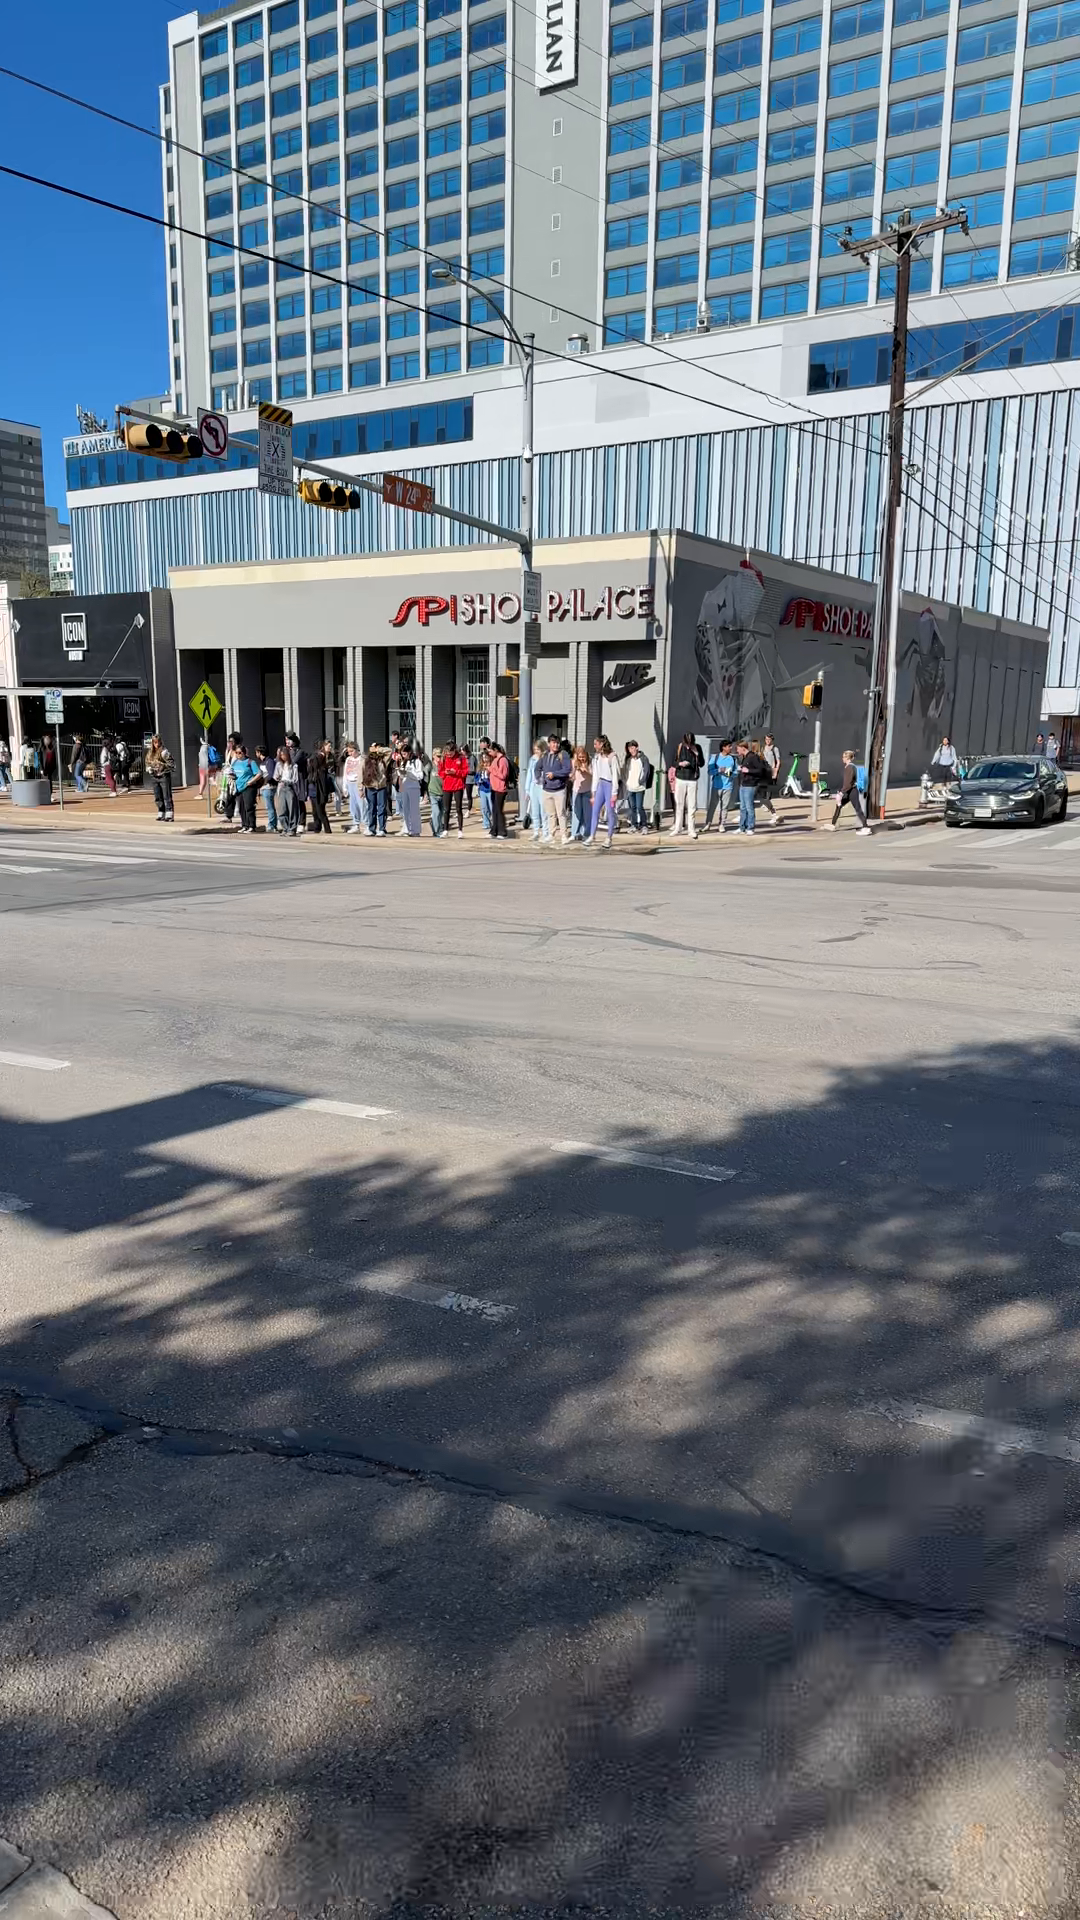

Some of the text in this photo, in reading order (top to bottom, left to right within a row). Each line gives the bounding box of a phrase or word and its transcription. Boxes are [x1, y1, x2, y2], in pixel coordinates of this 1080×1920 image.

[546, 0, 563, 73] LIAN
[82, 436, 126, 454] AMERIC
[264, 464, 288, 478] THE BOX
[267, 477, 275, 485] UP
[278, 487, 290, 495] FINE
[396, 480, 404, 502] W
[460, 592, 539, 625] SHO
[546, 584, 656, 622] PALACE
[822, 602, 859, 637] SHOE
[64, 622, 84, 641] ICON
[611, 663, 652, 686] NIKE
[124, 702, 139, 714] ICON
